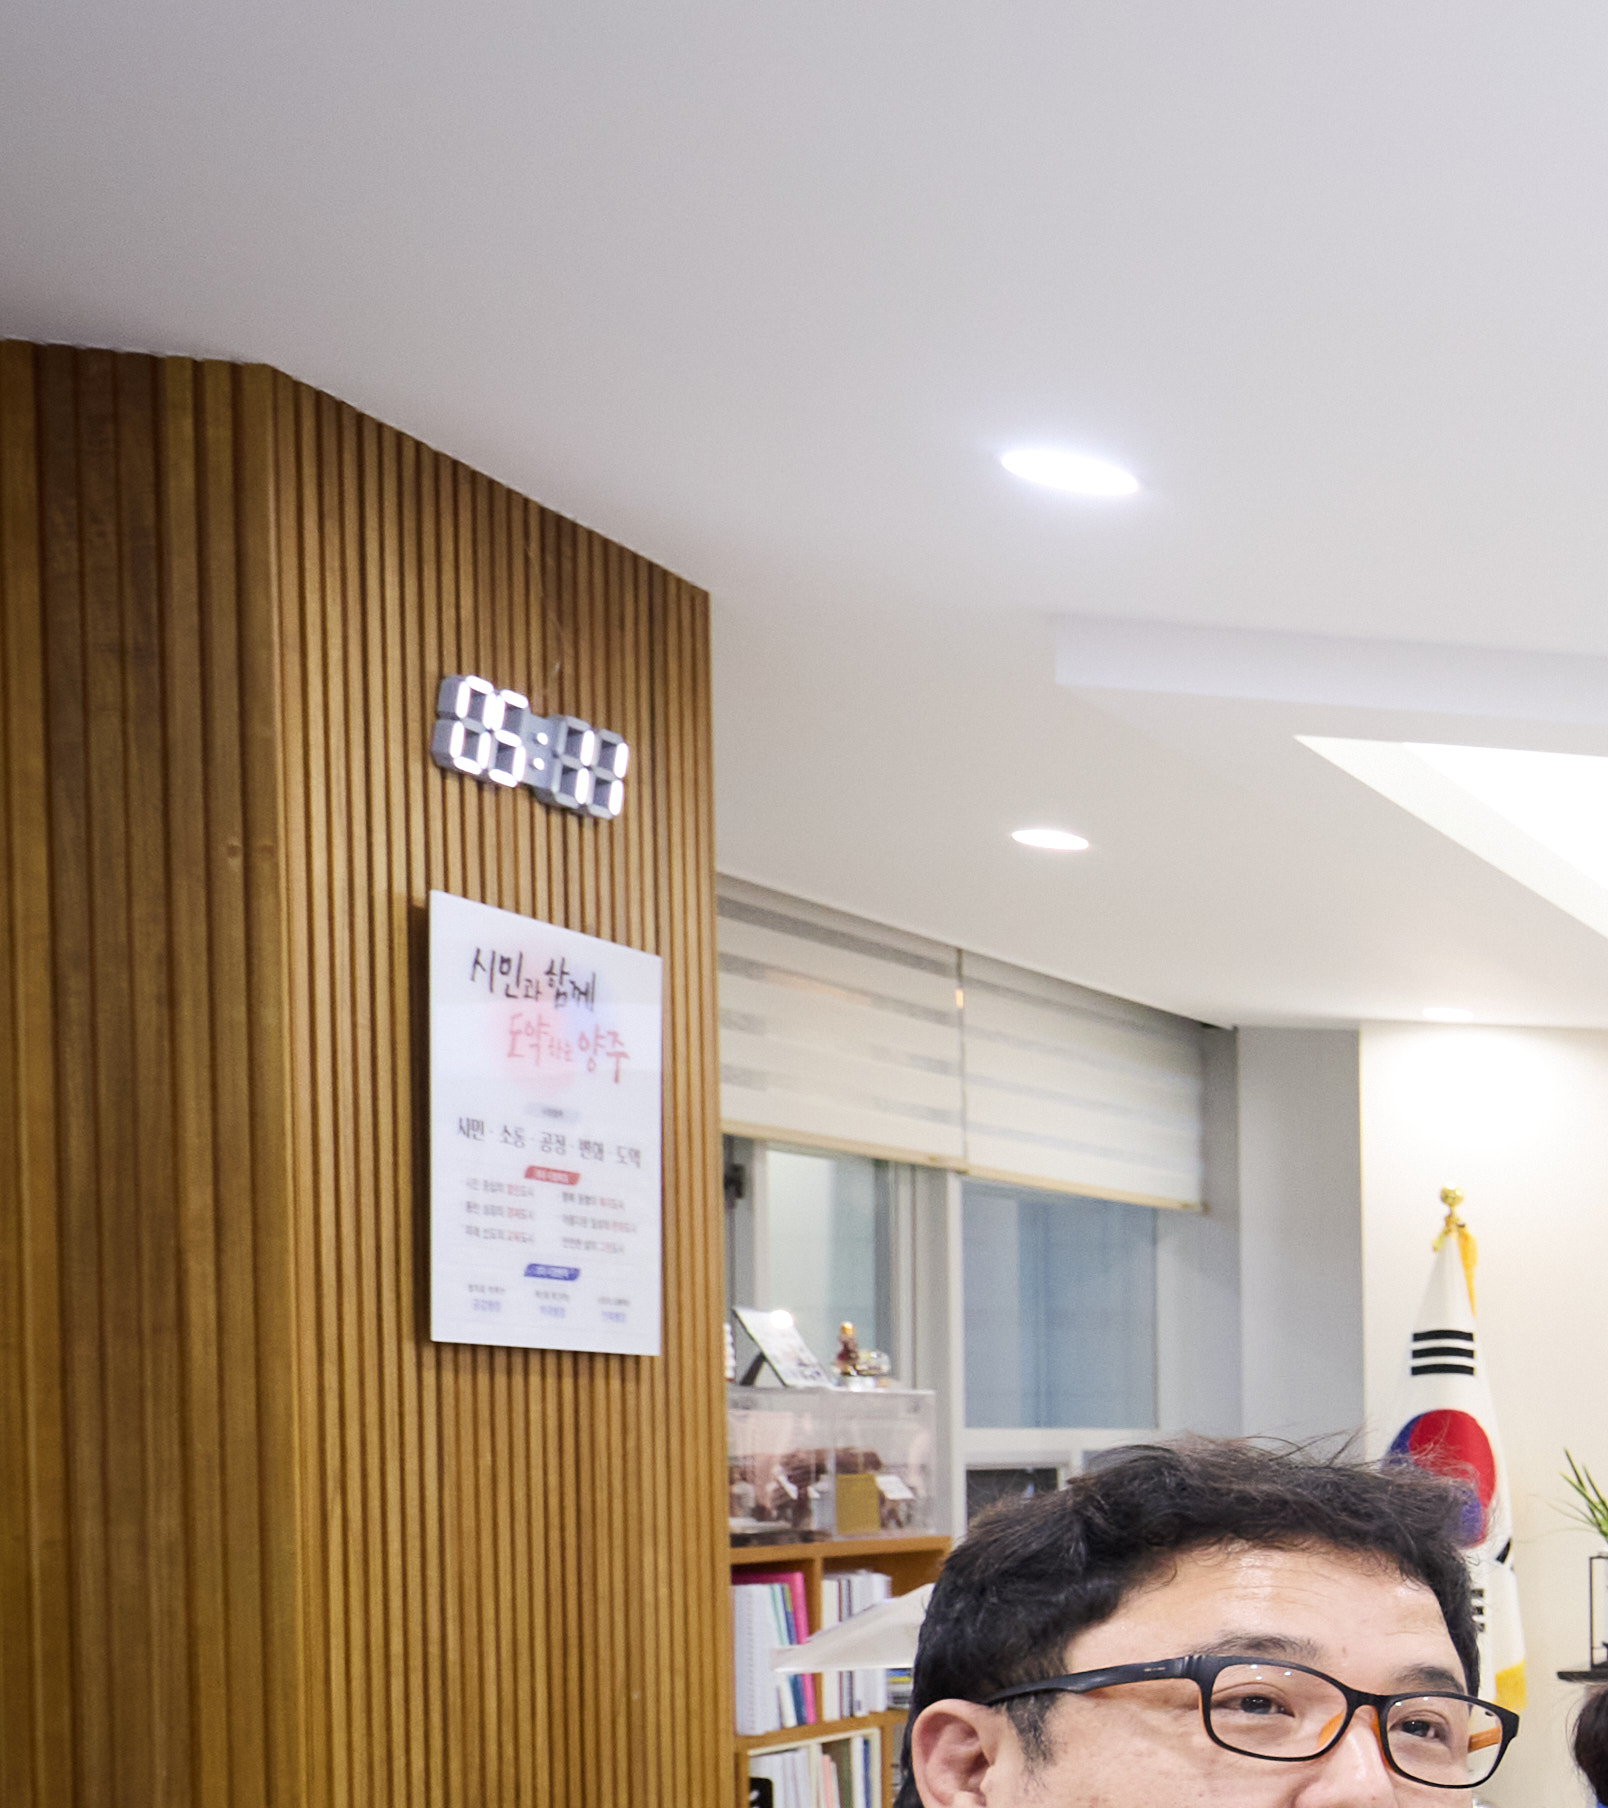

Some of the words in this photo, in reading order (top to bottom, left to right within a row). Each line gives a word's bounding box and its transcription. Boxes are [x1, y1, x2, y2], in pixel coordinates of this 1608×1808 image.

[450, 675, 628, 817] 05:11
[470, 948, 543, 1002] 시민과
[544, 957, 597, 1012] 함께
[578, 1024, 630, 1084] 양주
